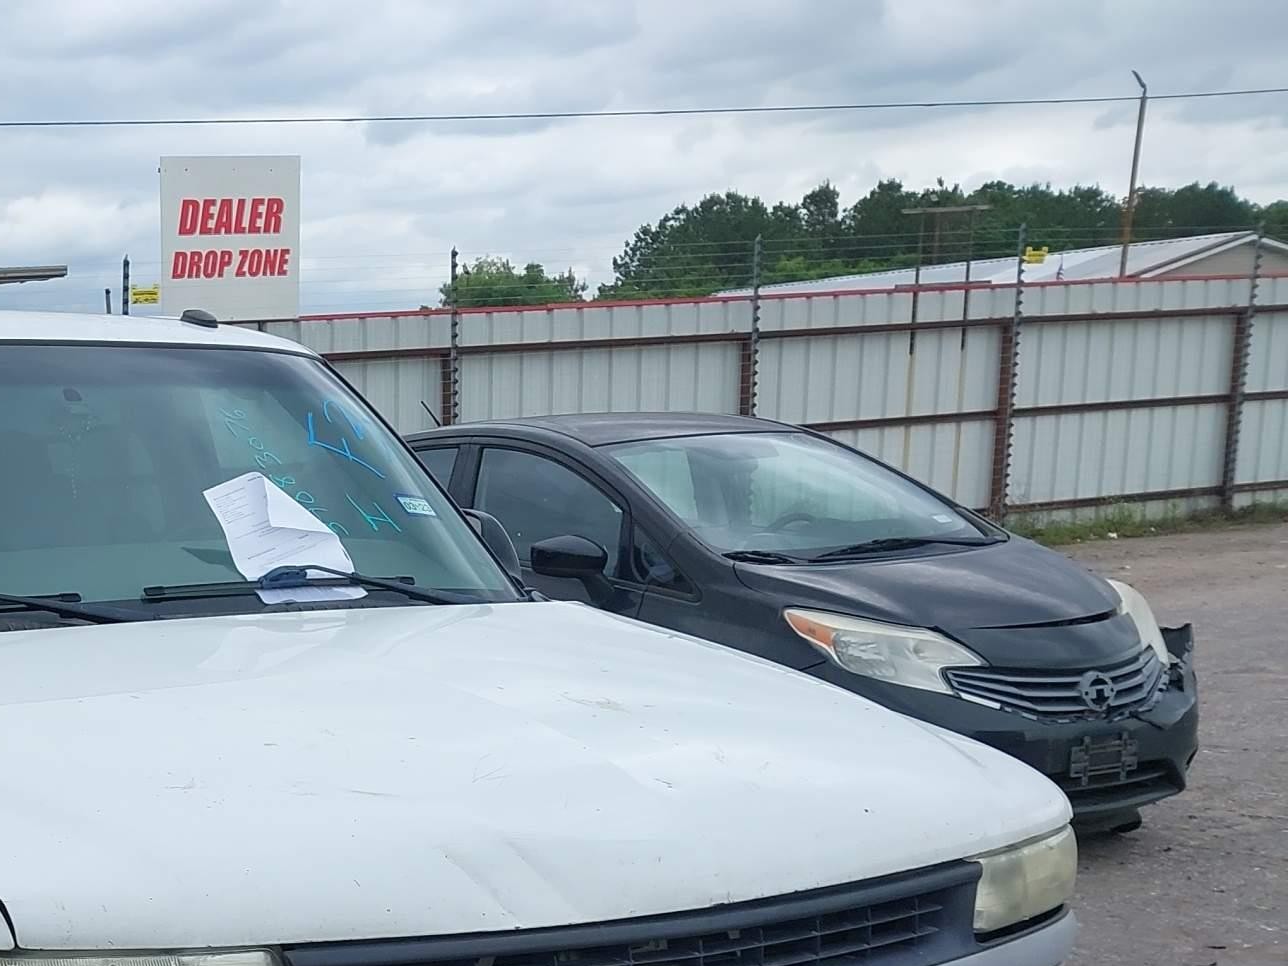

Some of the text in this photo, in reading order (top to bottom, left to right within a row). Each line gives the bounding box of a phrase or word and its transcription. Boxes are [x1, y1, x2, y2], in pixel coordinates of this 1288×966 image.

[178, 198, 284, 236] DEALER
[171, 248, 291, 279] DROP ZONE
